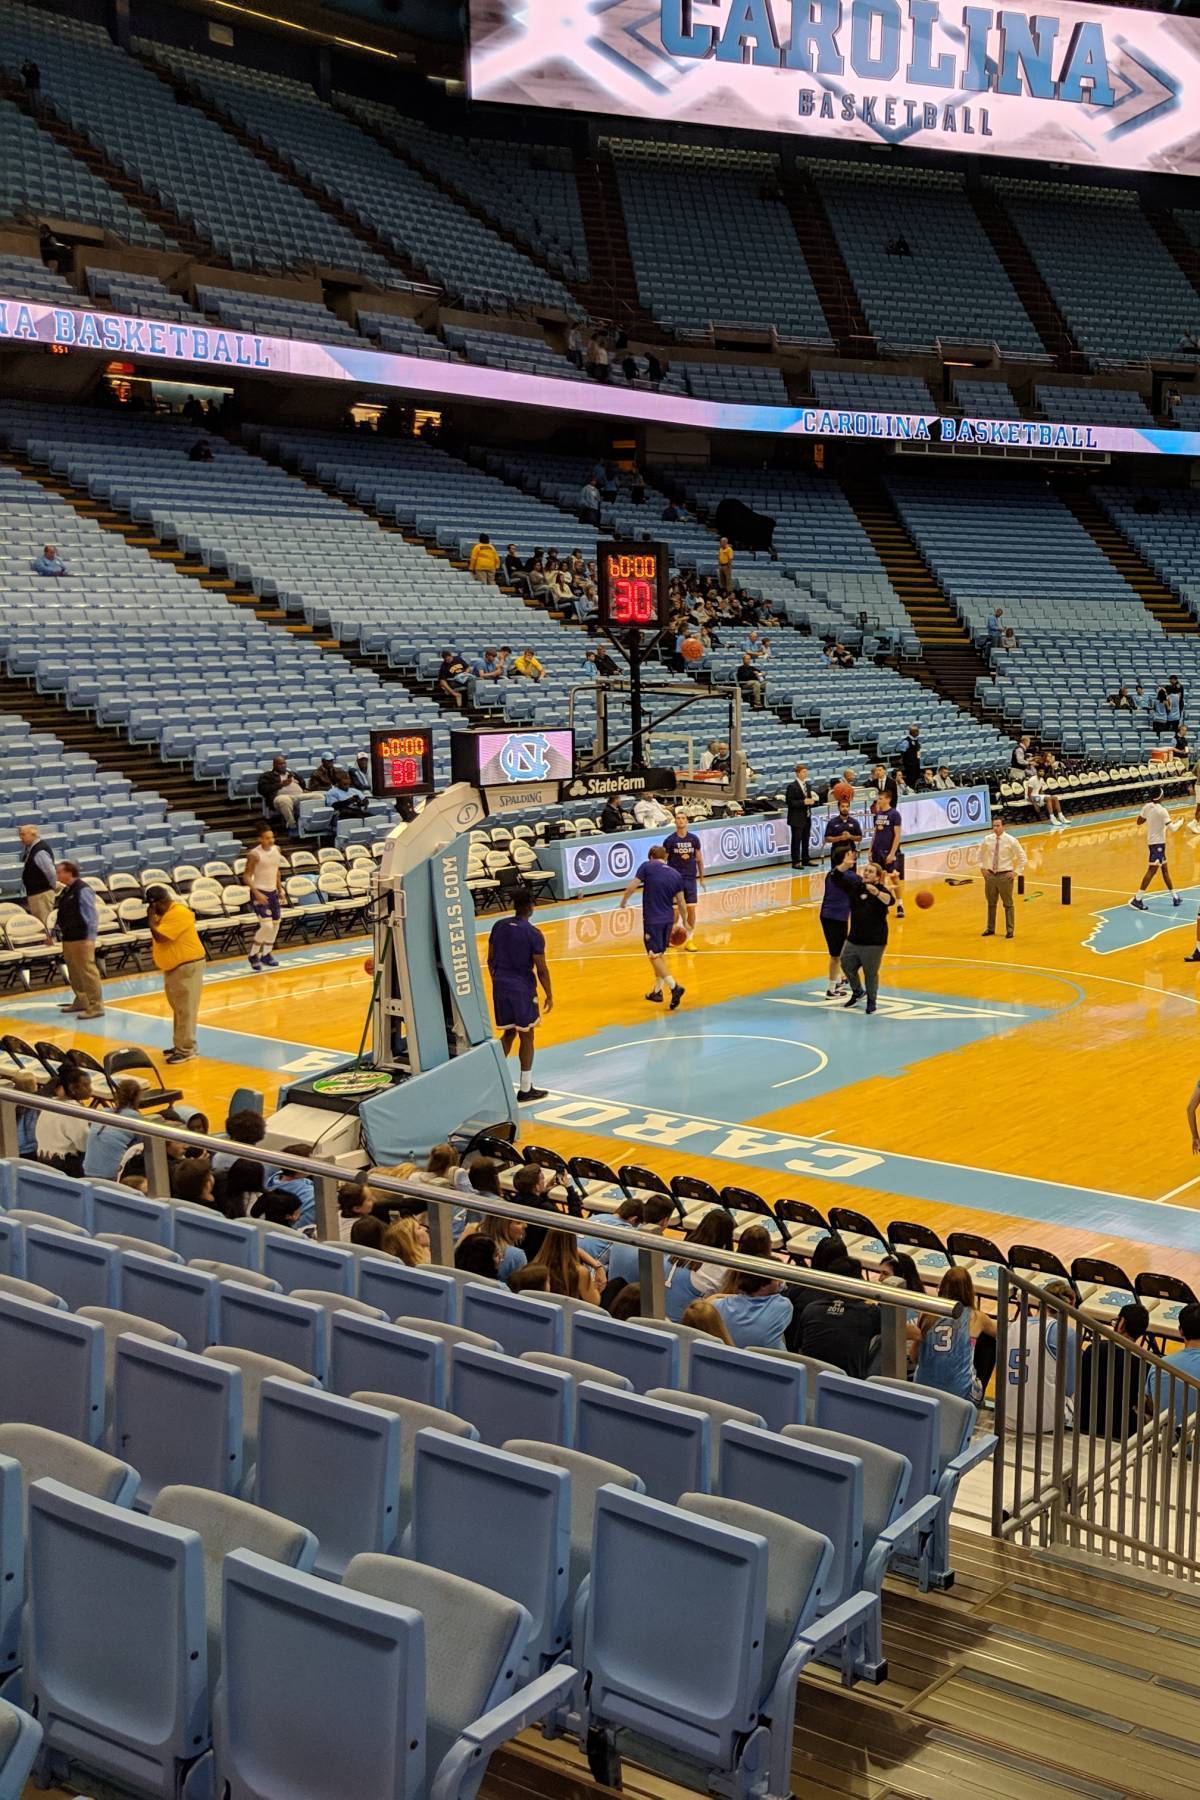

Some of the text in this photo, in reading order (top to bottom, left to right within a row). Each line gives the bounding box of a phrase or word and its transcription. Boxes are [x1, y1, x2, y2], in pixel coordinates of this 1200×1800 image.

[660, 0, 1116, 107] CAROLINA
[797, 88, 994, 137] BASKETBALL
[54, 309, 271, 367] BASKETBALL
[803, 410, 1098, 449] CAROLINA BASKETBALL
[612, 581, 653, 621] 30
[390, 759, 417, 786] 30
[500, 791, 542, 807] SPALDING
[442, 855, 472, 997] GOHEELS.COM
[932, 1324, 954, 1354] 3
